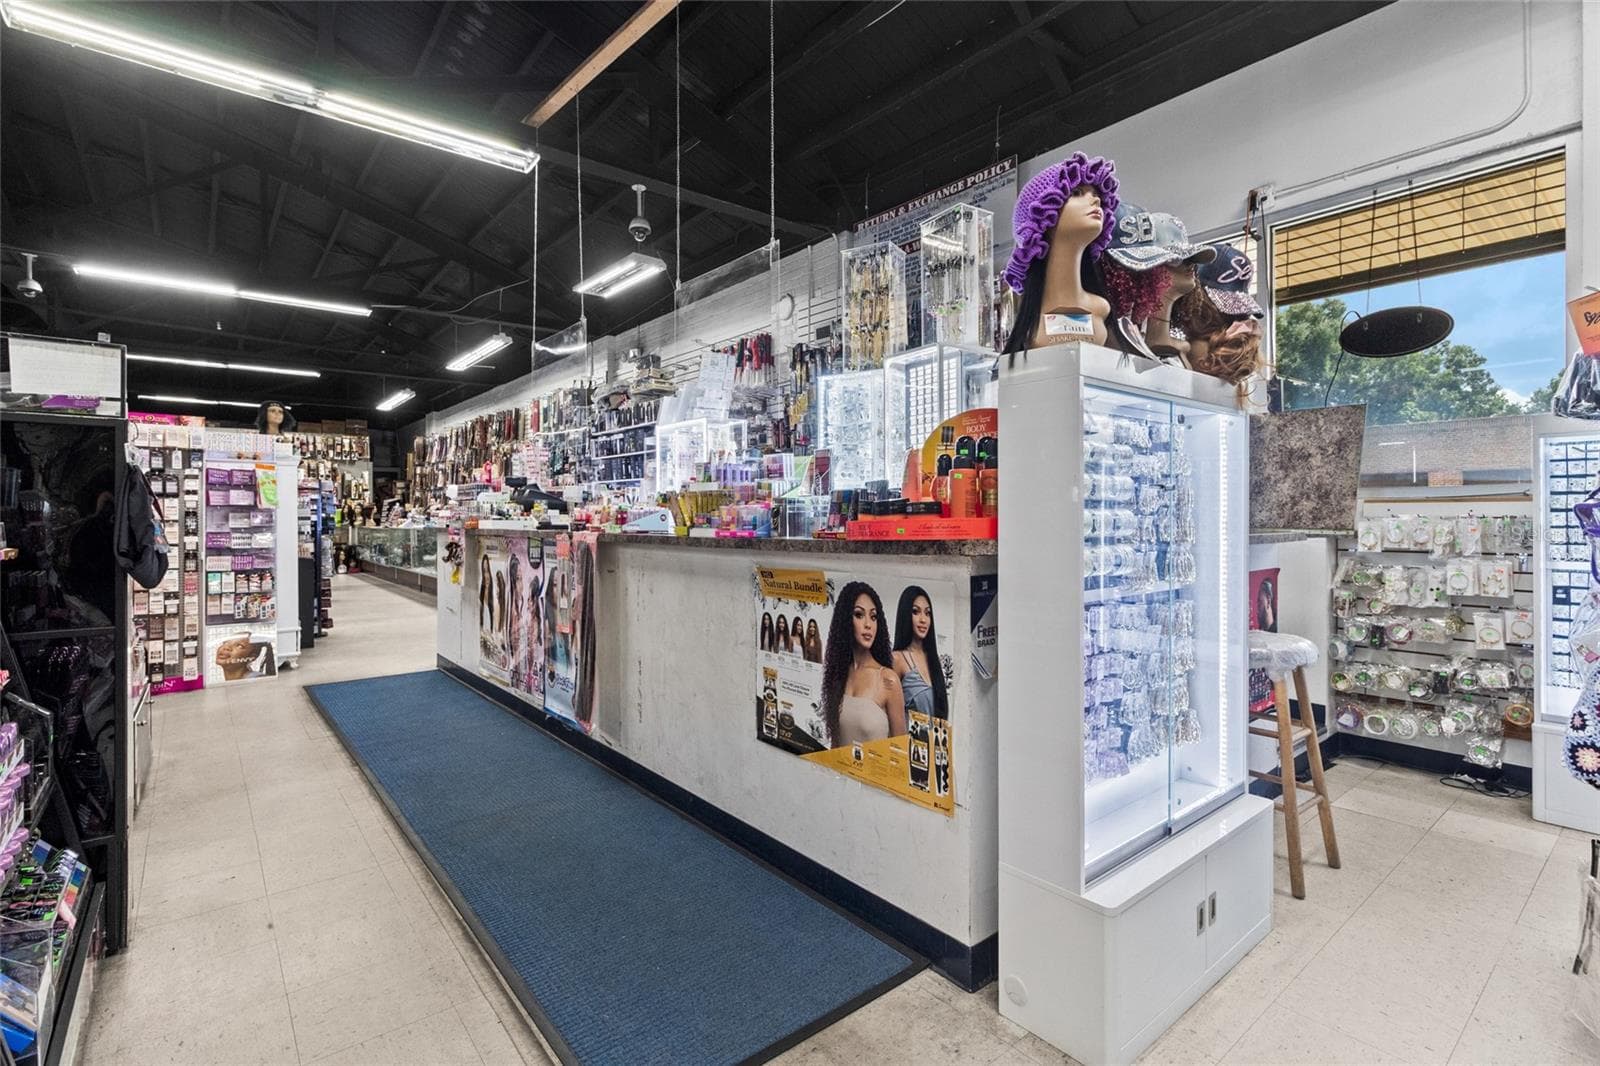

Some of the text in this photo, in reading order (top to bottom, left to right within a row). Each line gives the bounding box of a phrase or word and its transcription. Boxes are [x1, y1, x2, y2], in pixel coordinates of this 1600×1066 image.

[857, 209, 896, 231] RETURN
[898, 206, 906, 216] &
[908, 180, 965, 211] EXCHANGE
[966, 159, 1013, 187] POLICY
[763, 578, 823, 593] Natural Bundle
